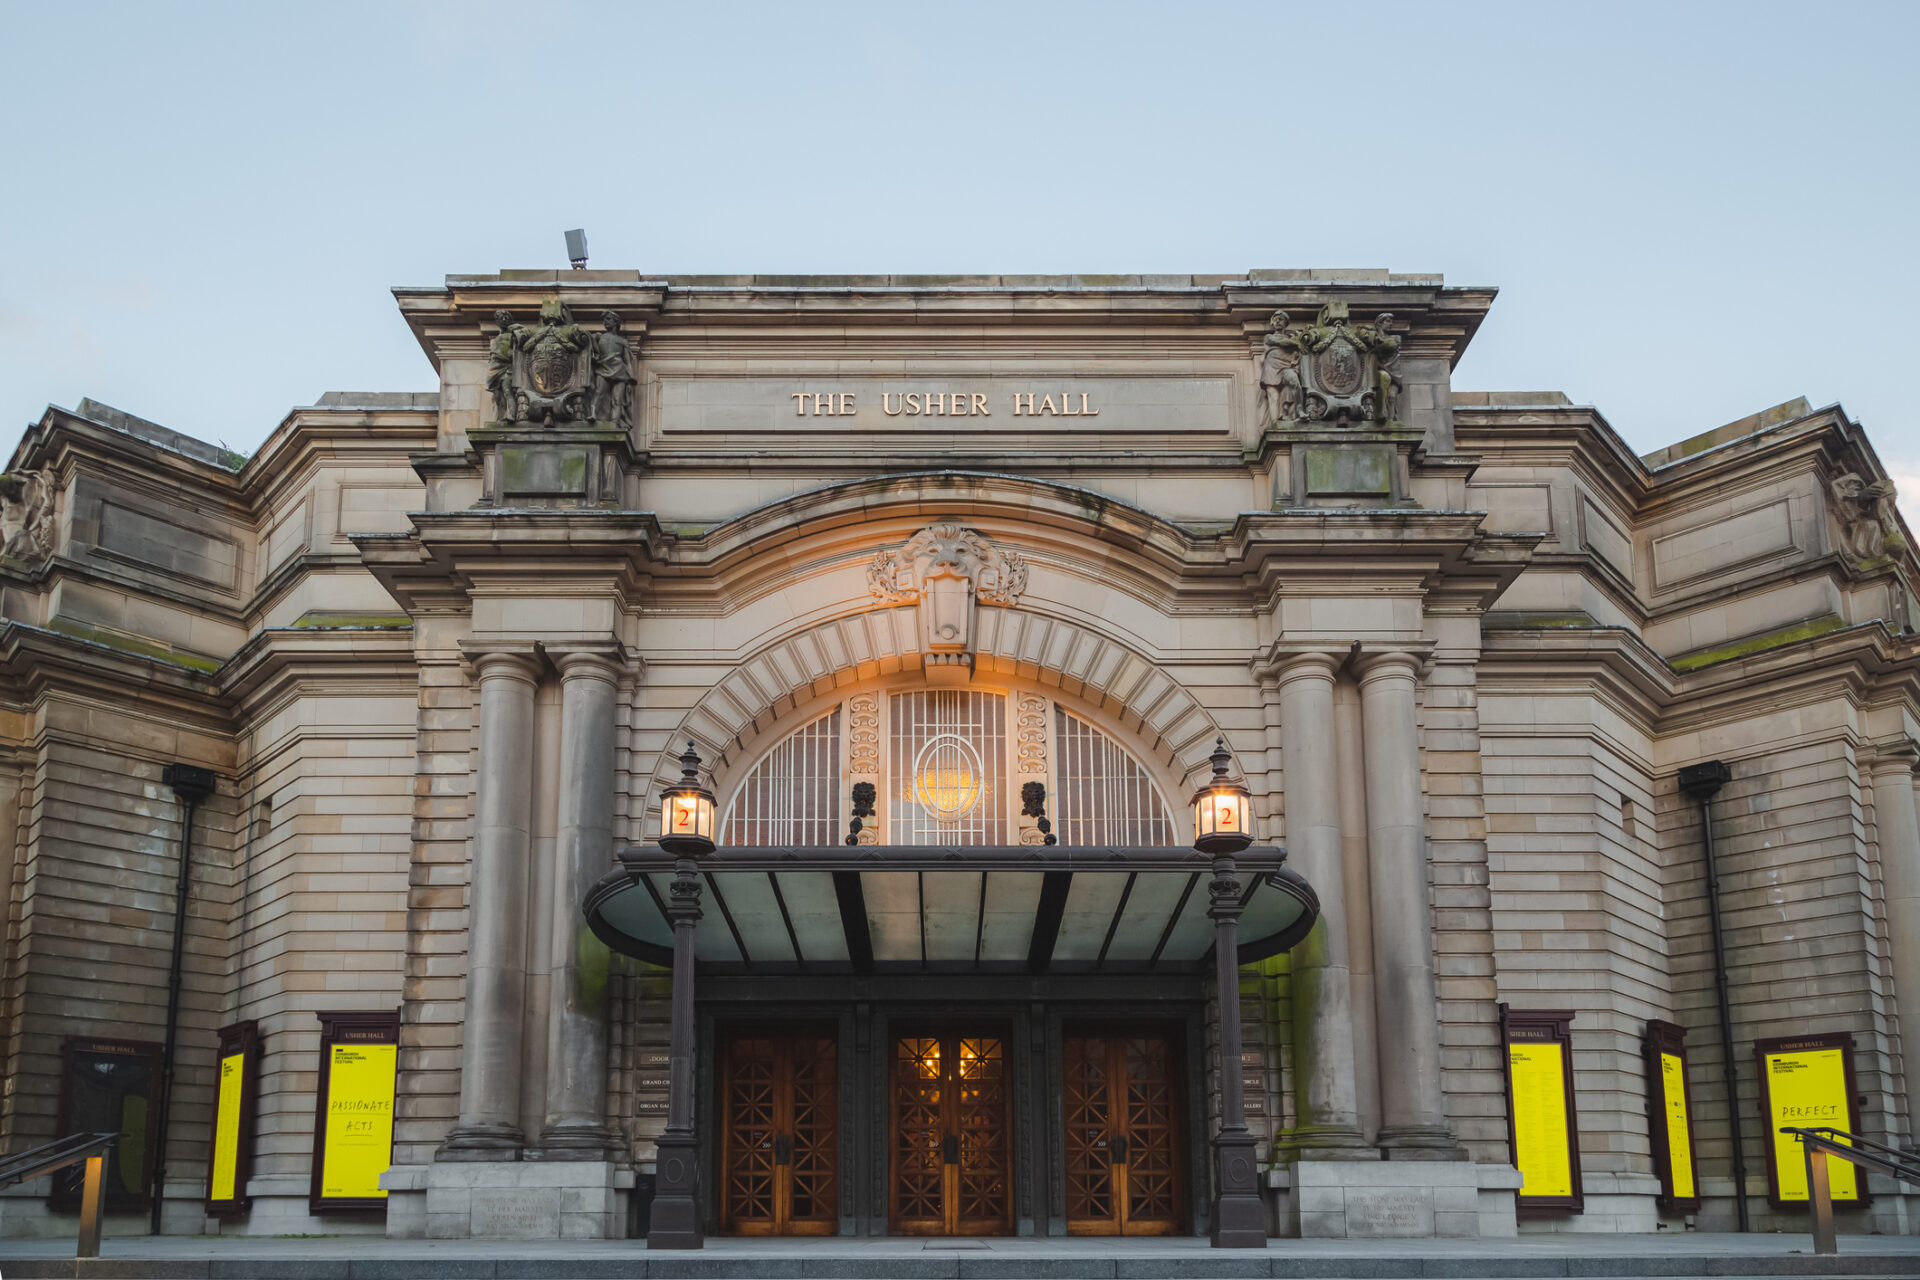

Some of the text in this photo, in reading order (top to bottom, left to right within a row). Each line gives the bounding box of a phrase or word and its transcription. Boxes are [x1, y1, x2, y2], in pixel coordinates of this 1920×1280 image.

[792, 392, 1100, 417] THE USHER HALL
[679, 809, 689, 826] 2
[1220, 807, 1232, 825] 2
[1780, 1042, 1804, 1050] USHER
[331, 1100, 391, 1112] PASSIONATE
[1782, 1105, 1838, 1117] PERFECT
[345, 1120, 374, 1132] ACTS
